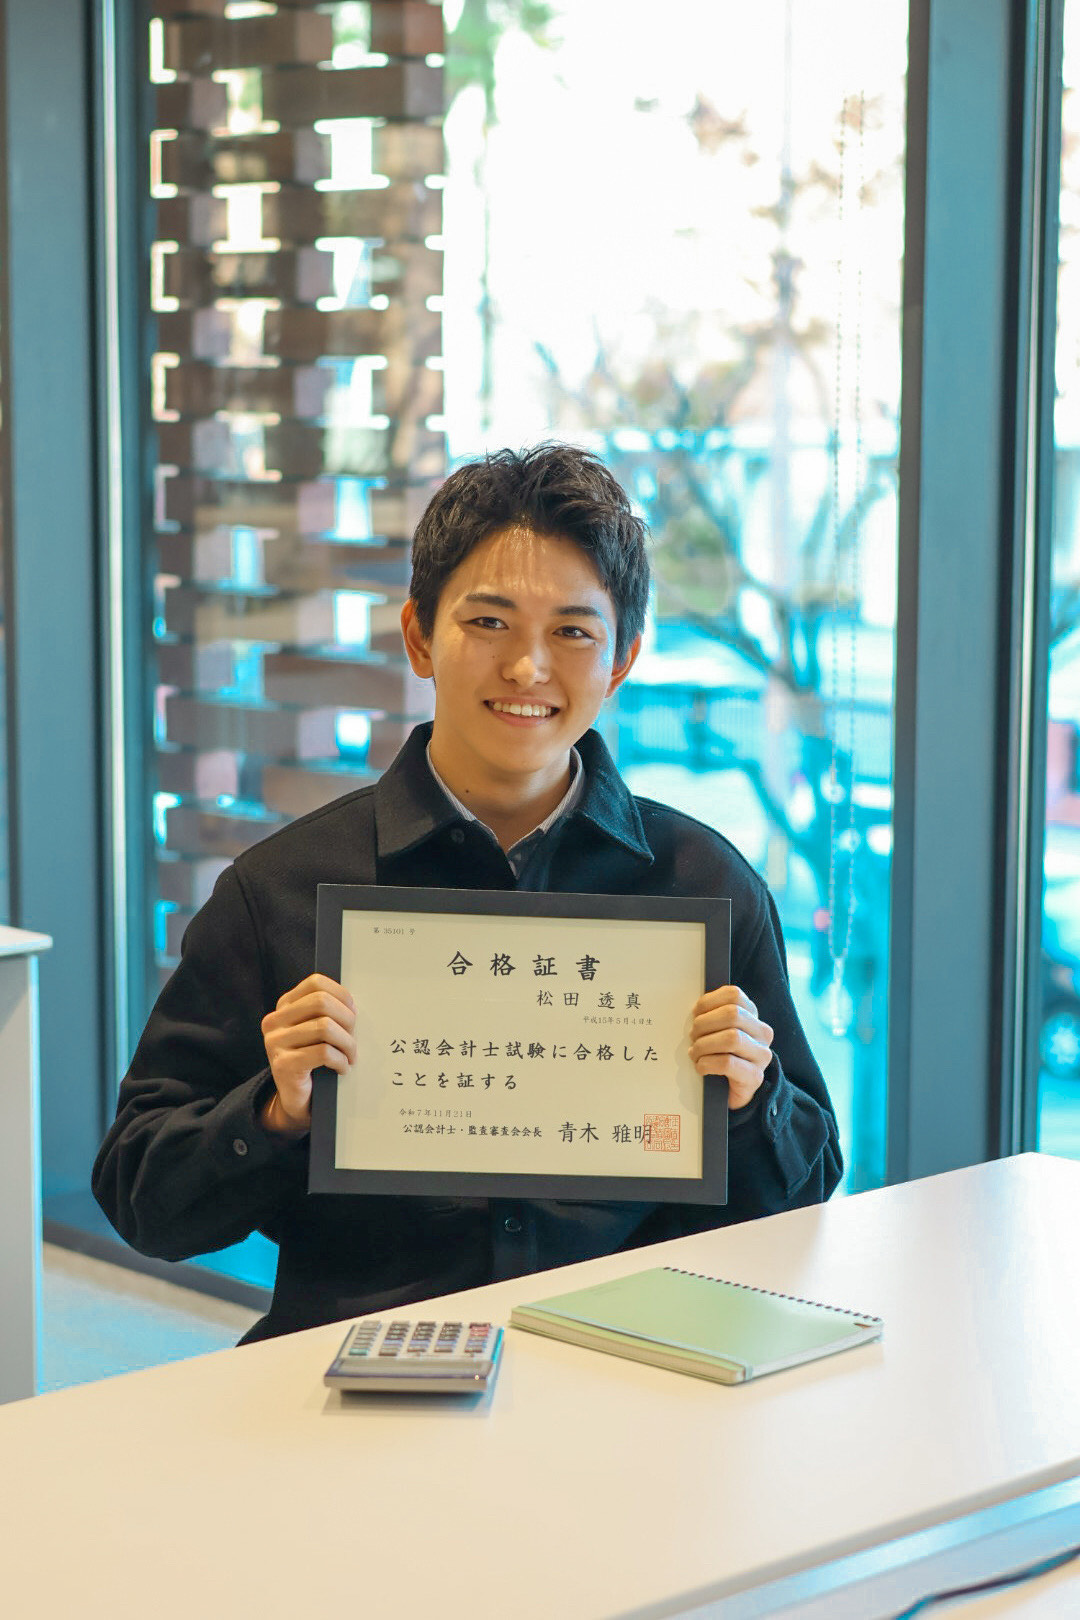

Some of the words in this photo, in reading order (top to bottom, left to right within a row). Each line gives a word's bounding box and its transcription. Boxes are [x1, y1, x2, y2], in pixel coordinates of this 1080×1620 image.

[446, 950, 601, 981] 合格証書
[536, 989, 580, 1007] 松田
[597, 991, 642, 1010] 透真
[389, 1038, 659, 1062] 公認会計士試験に合格した
[391, 1071, 518, 1091] ことを証する
[402, 1123, 543, 1138] 公認会計士・監査審査会会長
[558, 1121, 600, 1143] 青木
[611, 1123, 653, 1145] 雅明
